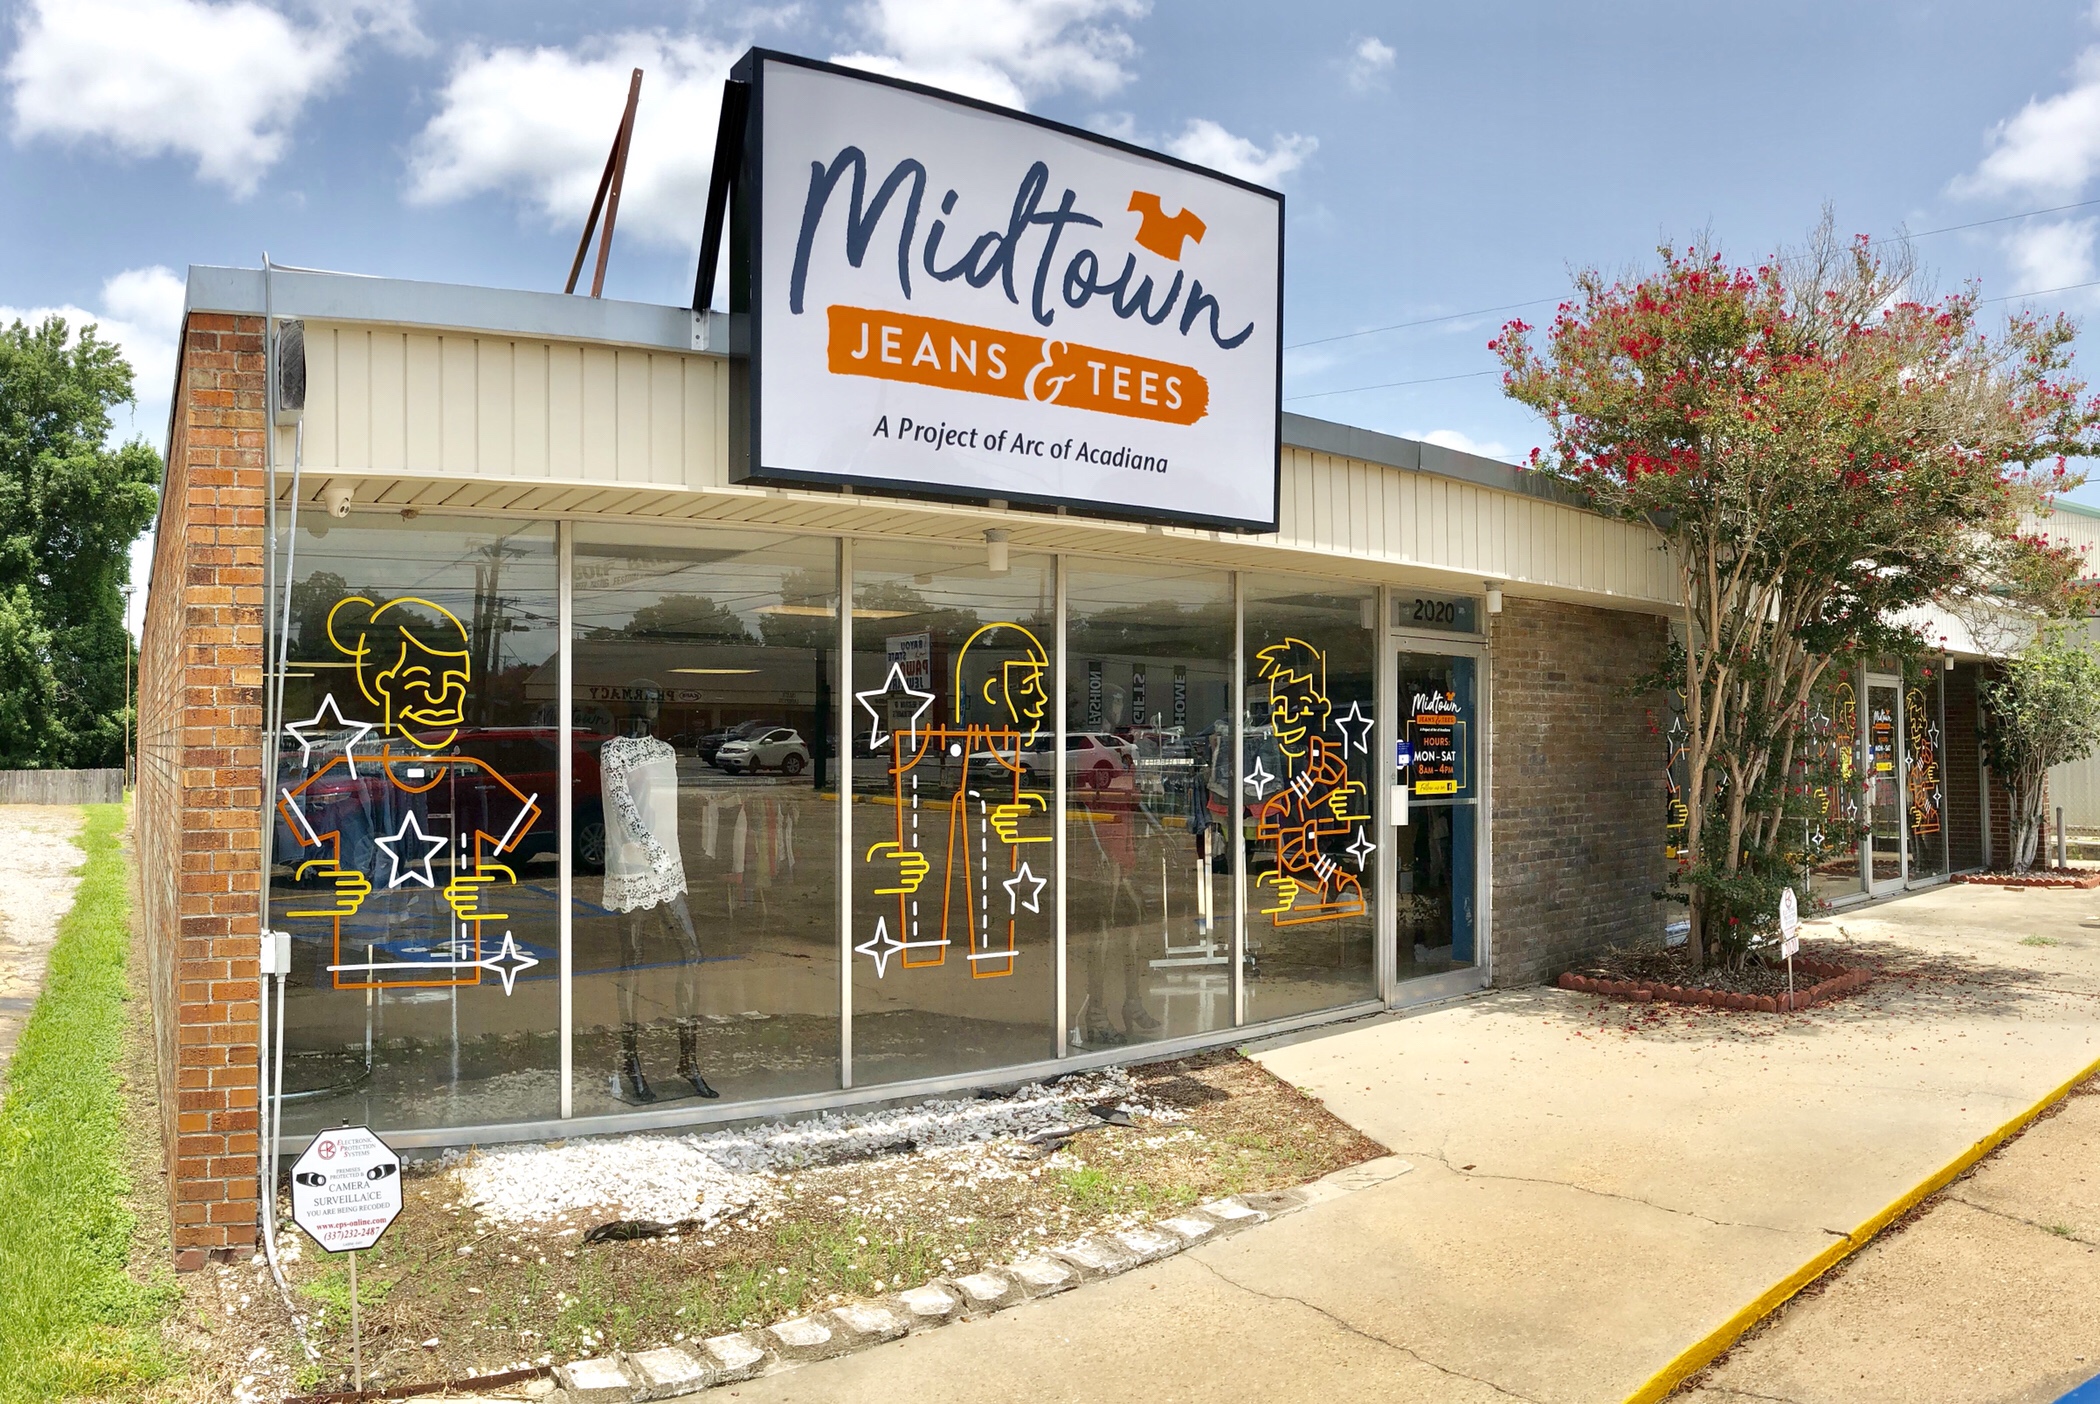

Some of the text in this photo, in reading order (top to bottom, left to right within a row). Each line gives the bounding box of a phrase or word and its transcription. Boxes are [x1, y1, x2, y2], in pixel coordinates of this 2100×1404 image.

[790, 146, 1254, 350] Midtown
[850, 322, 1183, 410] JEANS & TEES
[873, 415, 1168, 473] A Project of Arc of Acadiana
[1413, 598, 1455, 624] 2020
[1411, 690, 1461, 717] Midtown
[1423, 737, 1450, 746] HOURS:
[337, 1137, 373, 1146] ELECTRONIC
[340, 1143, 376, 1152] PROTECTION
[344, 1150, 370, 1158] SYSTEMS
[329, 1181, 371, 1192] CAMERA
[337, 1206, 358, 1214] BEING
[316, 1217, 387, 1230] www.eps-online.com
